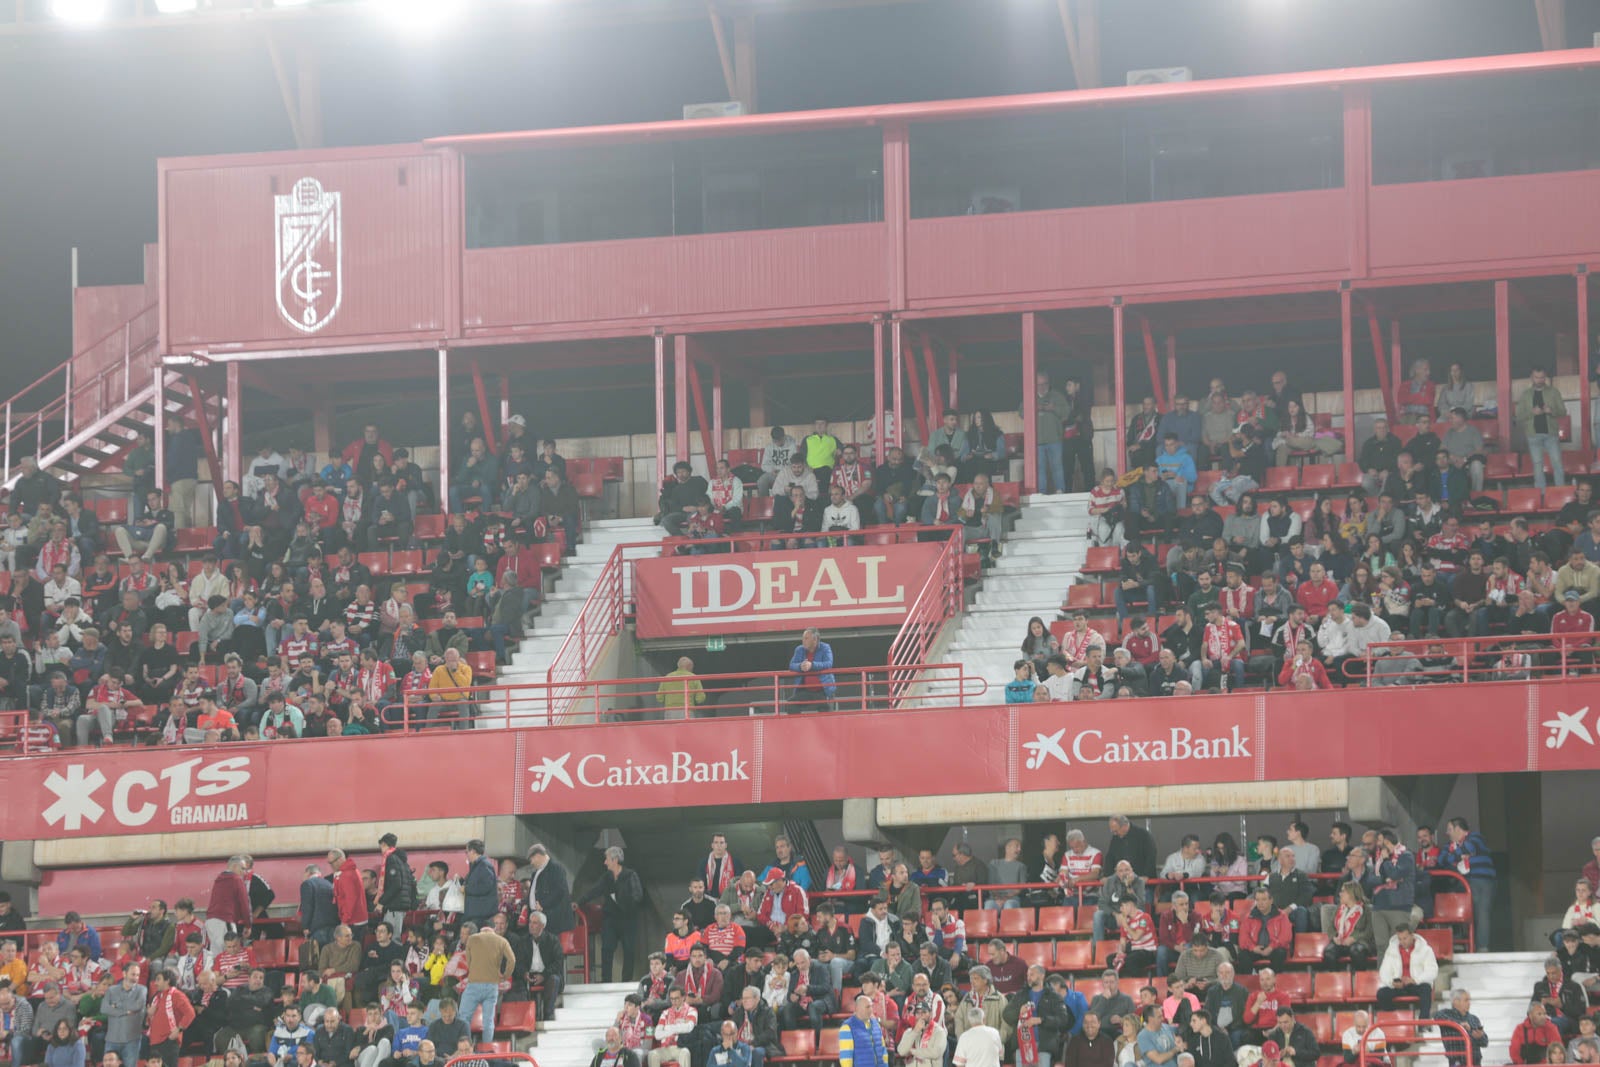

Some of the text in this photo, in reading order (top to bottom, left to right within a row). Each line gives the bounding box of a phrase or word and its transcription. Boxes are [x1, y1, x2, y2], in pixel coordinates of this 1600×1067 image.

[672, 555, 905, 615] IDEAL
[1072, 725, 1252, 764] CaixaBank
[576, 748, 750, 787] CaixaBank
[170, 803, 248, 825] GRANADA
